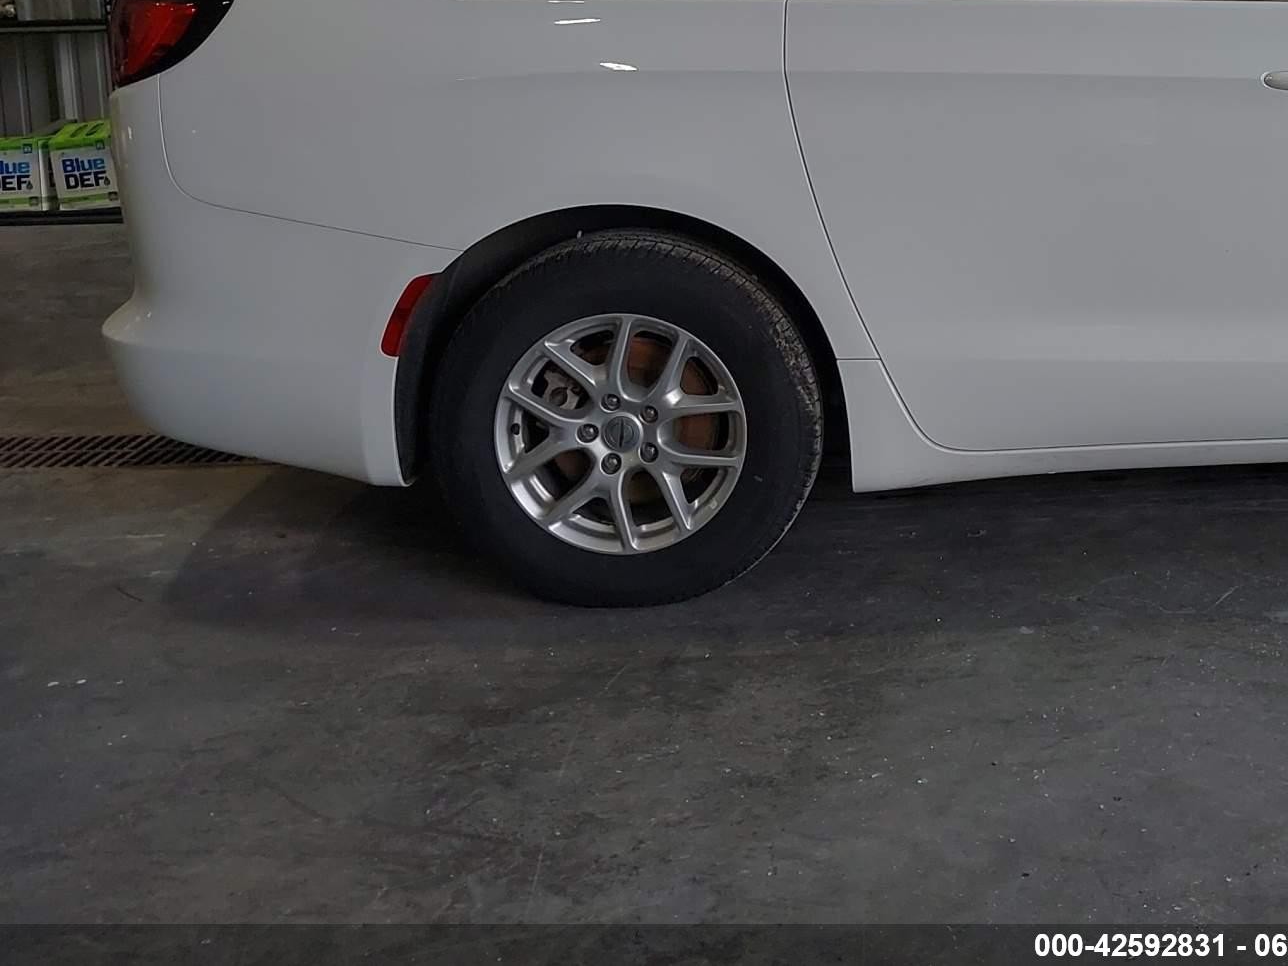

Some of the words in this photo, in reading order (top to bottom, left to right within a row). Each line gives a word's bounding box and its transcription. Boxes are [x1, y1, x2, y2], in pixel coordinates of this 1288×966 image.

[0, 160, 30, 175] lue
[61, 157, 105, 174] Blue
[0, 174, 31, 191] EF
[64, 170, 106, 190] DEF
